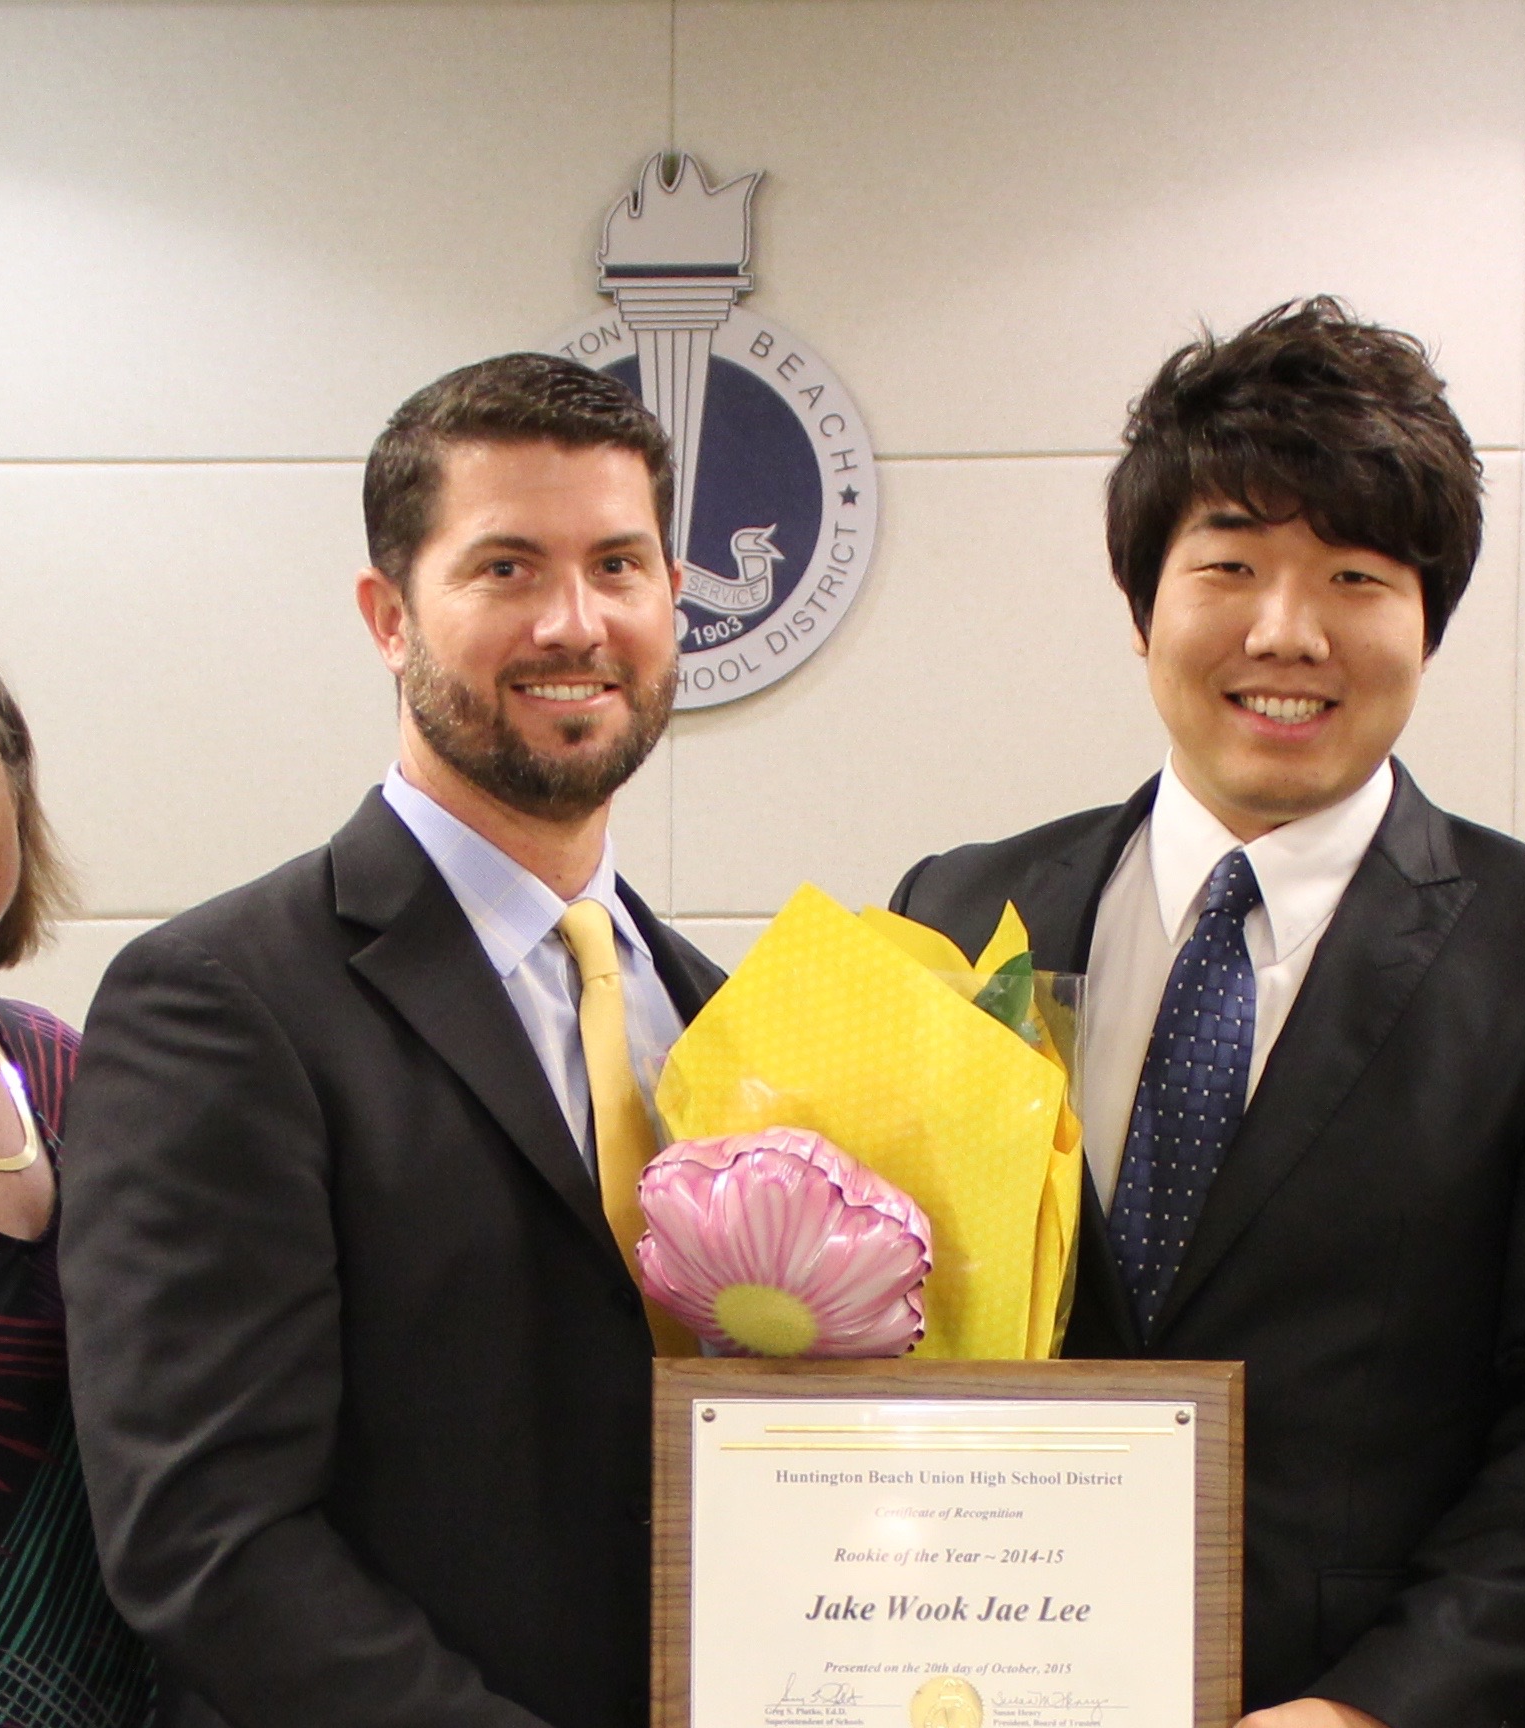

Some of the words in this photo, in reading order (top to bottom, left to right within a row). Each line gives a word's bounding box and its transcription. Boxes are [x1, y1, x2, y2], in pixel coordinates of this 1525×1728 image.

[749, 330, 858, 473] BEACH
[688, 575, 763, 605] SERVICE
[676, 652, 761, 693] HOOL
[765, 520, 857, 655] DISTRICT
[690, 615, 744, 646] 1903
[775, 1469, 863, 1486] Huntington
[868, 1470, 914, 1484] Beach
[919, 1470, 965, 1484] Union
[970, 1471, 1006, 1487] High
[1011, 1471, 1062, 1485] School
[1066, 1471, 1123, 1485] District
[874, 1506, 936, 1519] Certificate
[938, 1507, 952, 1520] of
[954, 1507, 1024, 1520] Recognition
[834, 1548, 890, 1563] Rookie
[893, 1549, 911, 1566] of
[914, 1549, 940, 1563] the
[945, 1548, 982, 1563] Year
[1000, 1549, 1065, 1564] 2014-15
[805, 1594, 877, 1621] Jake
[887, 1595, 969, 1621] Wook
[976, 1596, 1030, 1622] Jae
[1038, 1596, 1091, 1622] Lee
[824, 1662, 881, 1673] Presented
[884, 1664, 899, 1673] on
[902, 1662, 920, 1673] the
[923, 1662, 949, 1673] 20th
[952, 1663, 972, 1676] day
[976, 1663, 990, 1675] of
[991, 1663, 1040, 1674] October,
[1044, 1663, 1072, 1674] 2015
